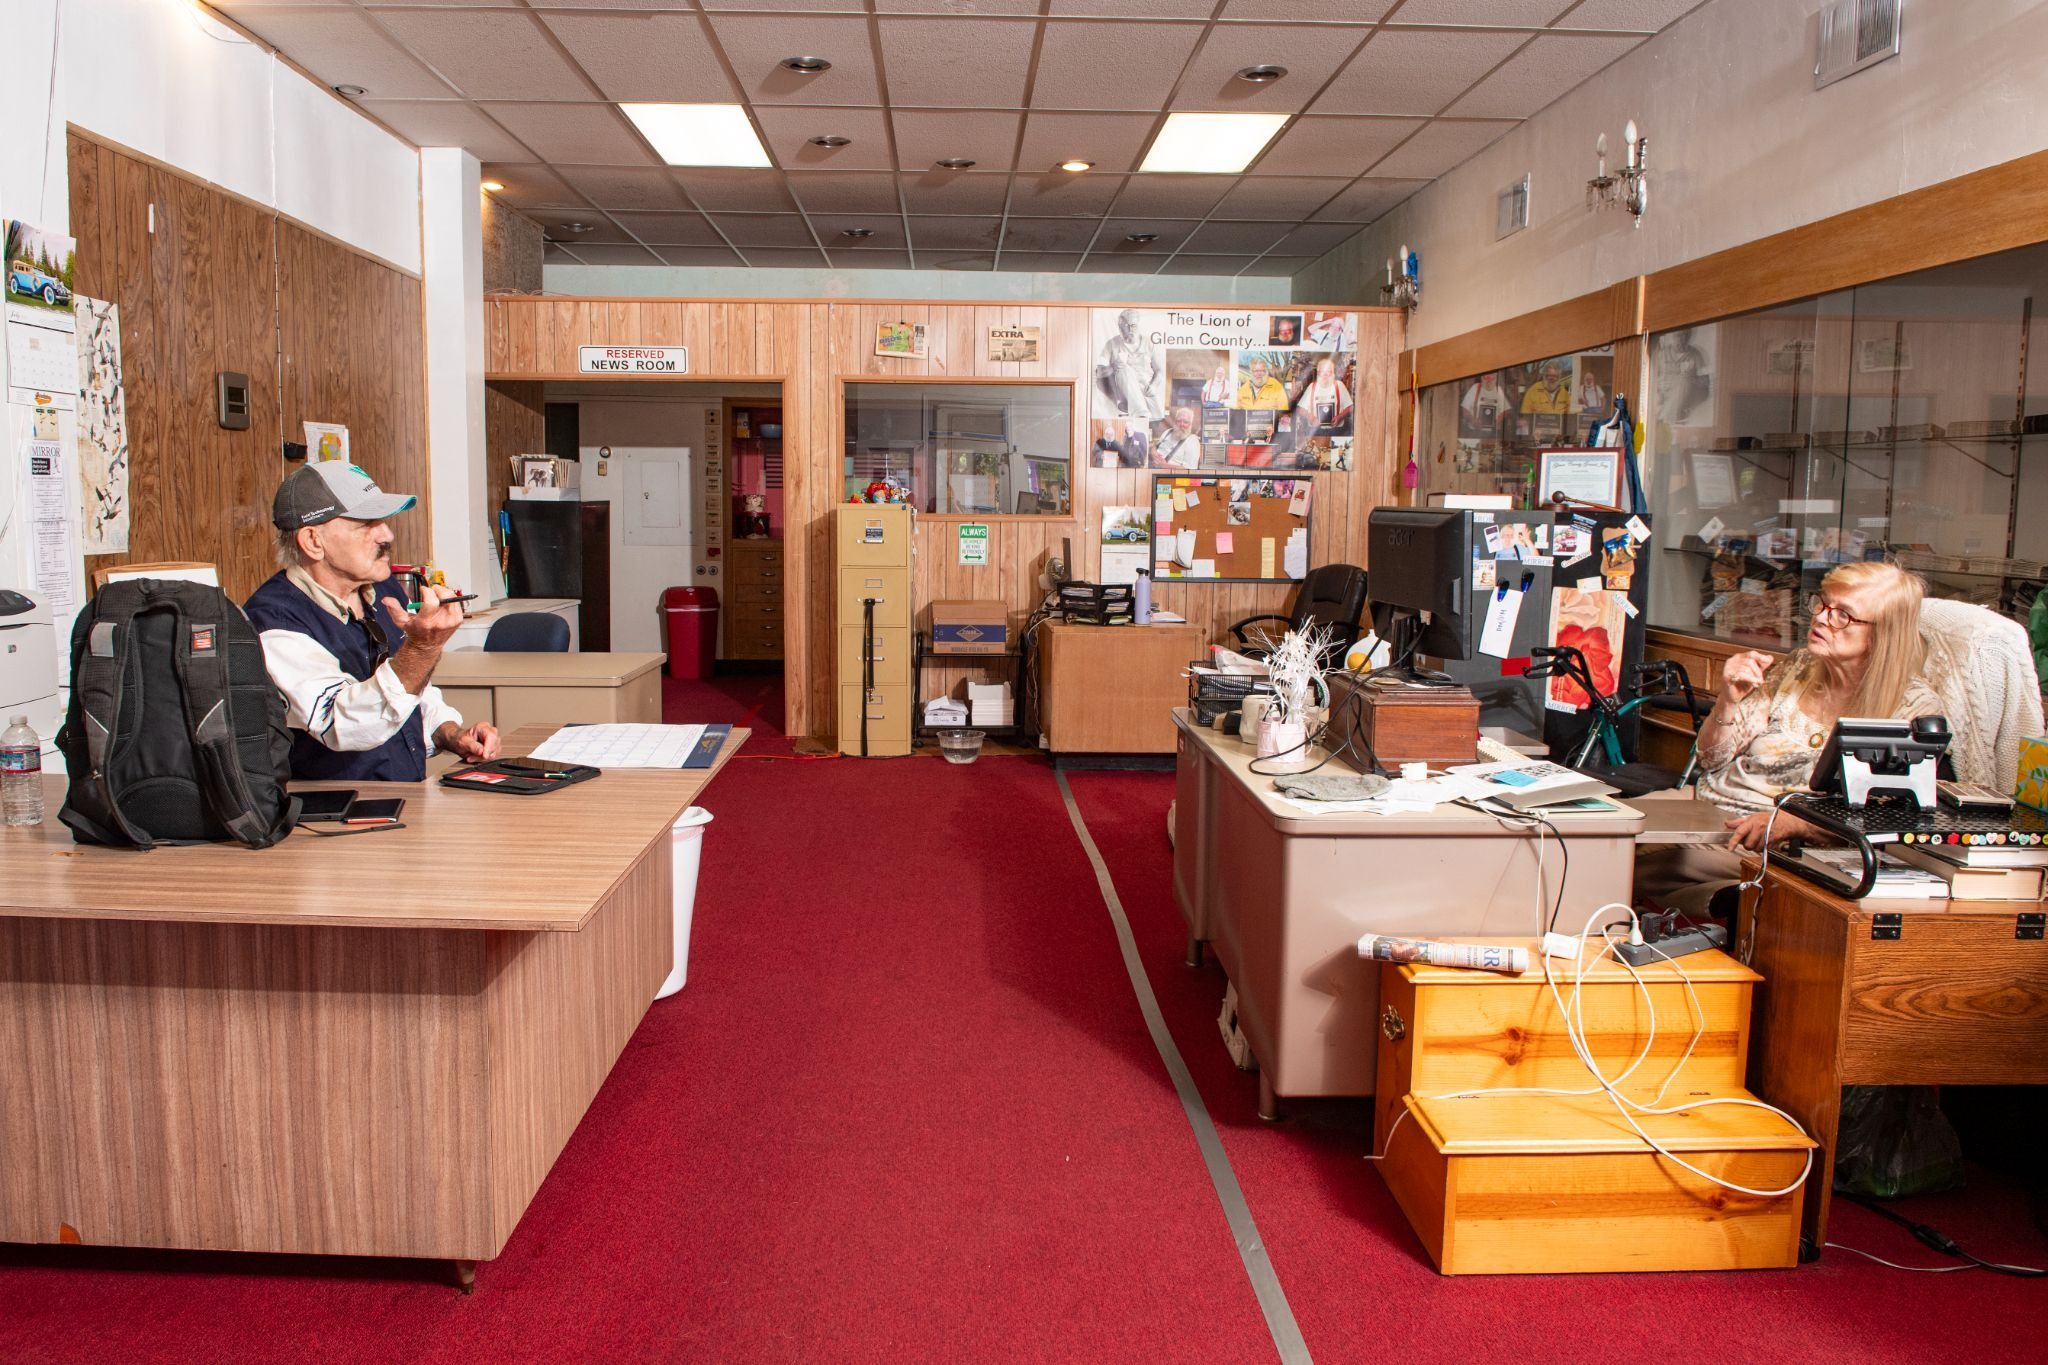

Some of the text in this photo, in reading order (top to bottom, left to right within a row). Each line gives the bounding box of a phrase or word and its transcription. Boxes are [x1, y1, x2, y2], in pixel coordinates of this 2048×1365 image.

[1168, 312, 1252, 327] The Lion of
[992, 330, 1024, 338] EXTRA
[1150, 332, 1266, 349] Glenn County...
[606, 350, 664, 359] RESERVED
[592, 360, 675, 371] NEWS ROOM
[31, 446, 60, 457] MIRROR
[961, 528, 987, 537] ALWAYS
[1388, 528, 1415, 545] acer
